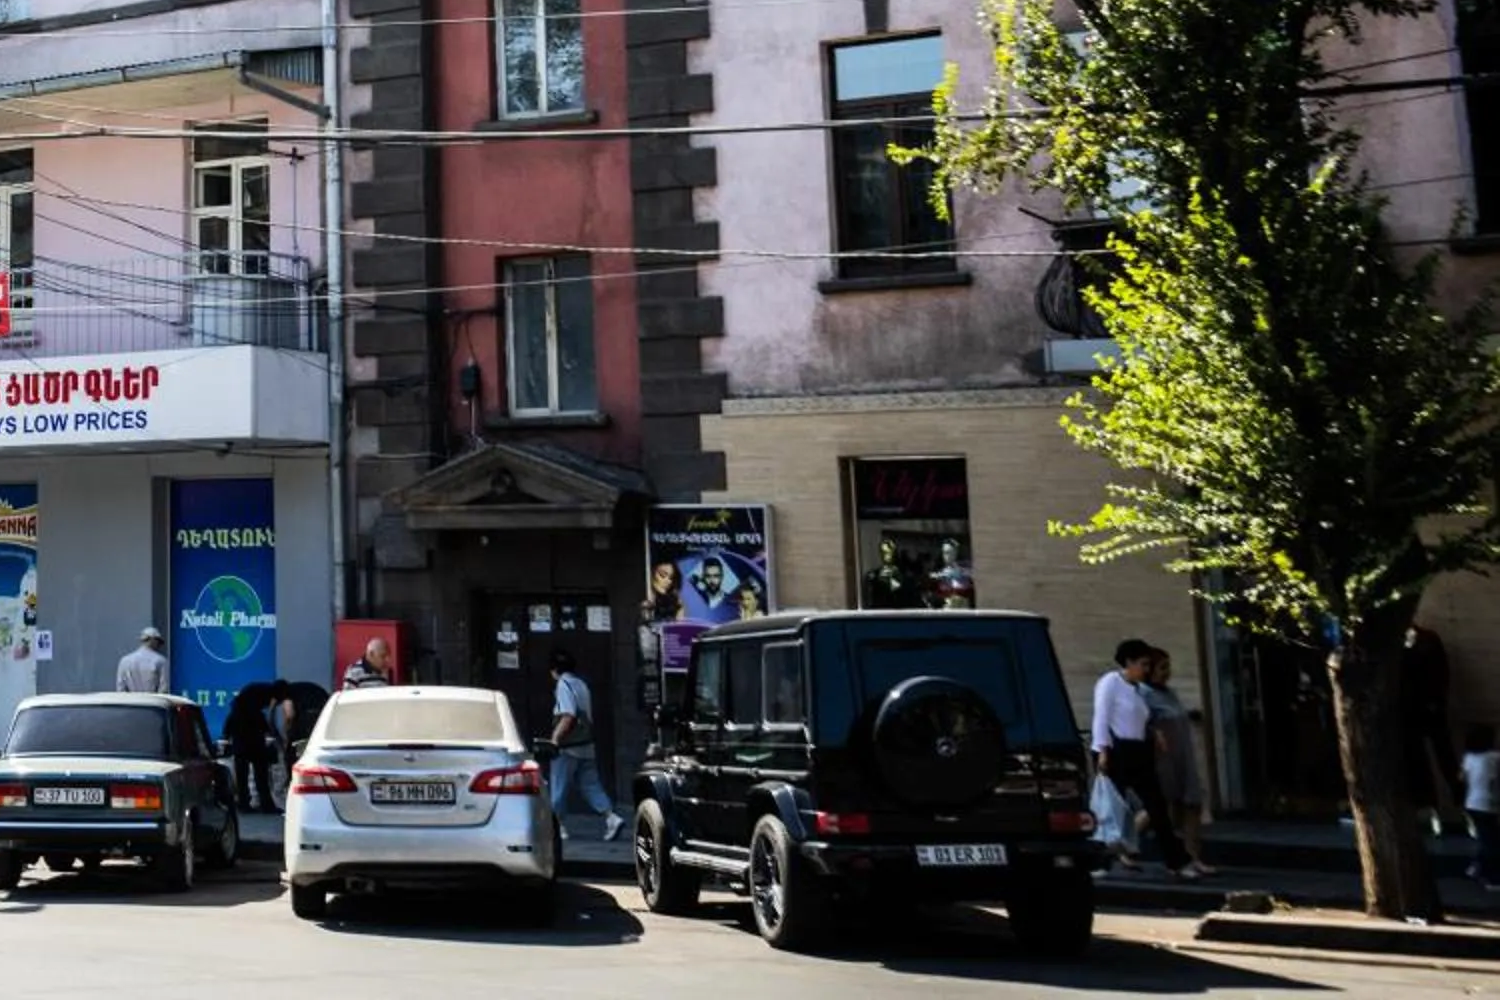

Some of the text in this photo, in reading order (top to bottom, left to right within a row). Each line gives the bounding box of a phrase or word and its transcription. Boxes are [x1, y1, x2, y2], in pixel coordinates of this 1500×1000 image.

[5, 371, 79, 407] ՑԱԾՐ
[84, 366, 160, 403] ԳՆԵՐ
[23, 413, 69, 433] LOW
[74, 410, 148, 431] PRICES
[179, 609, 224, 629] Natali
[427, 785, 450, 799] 096
